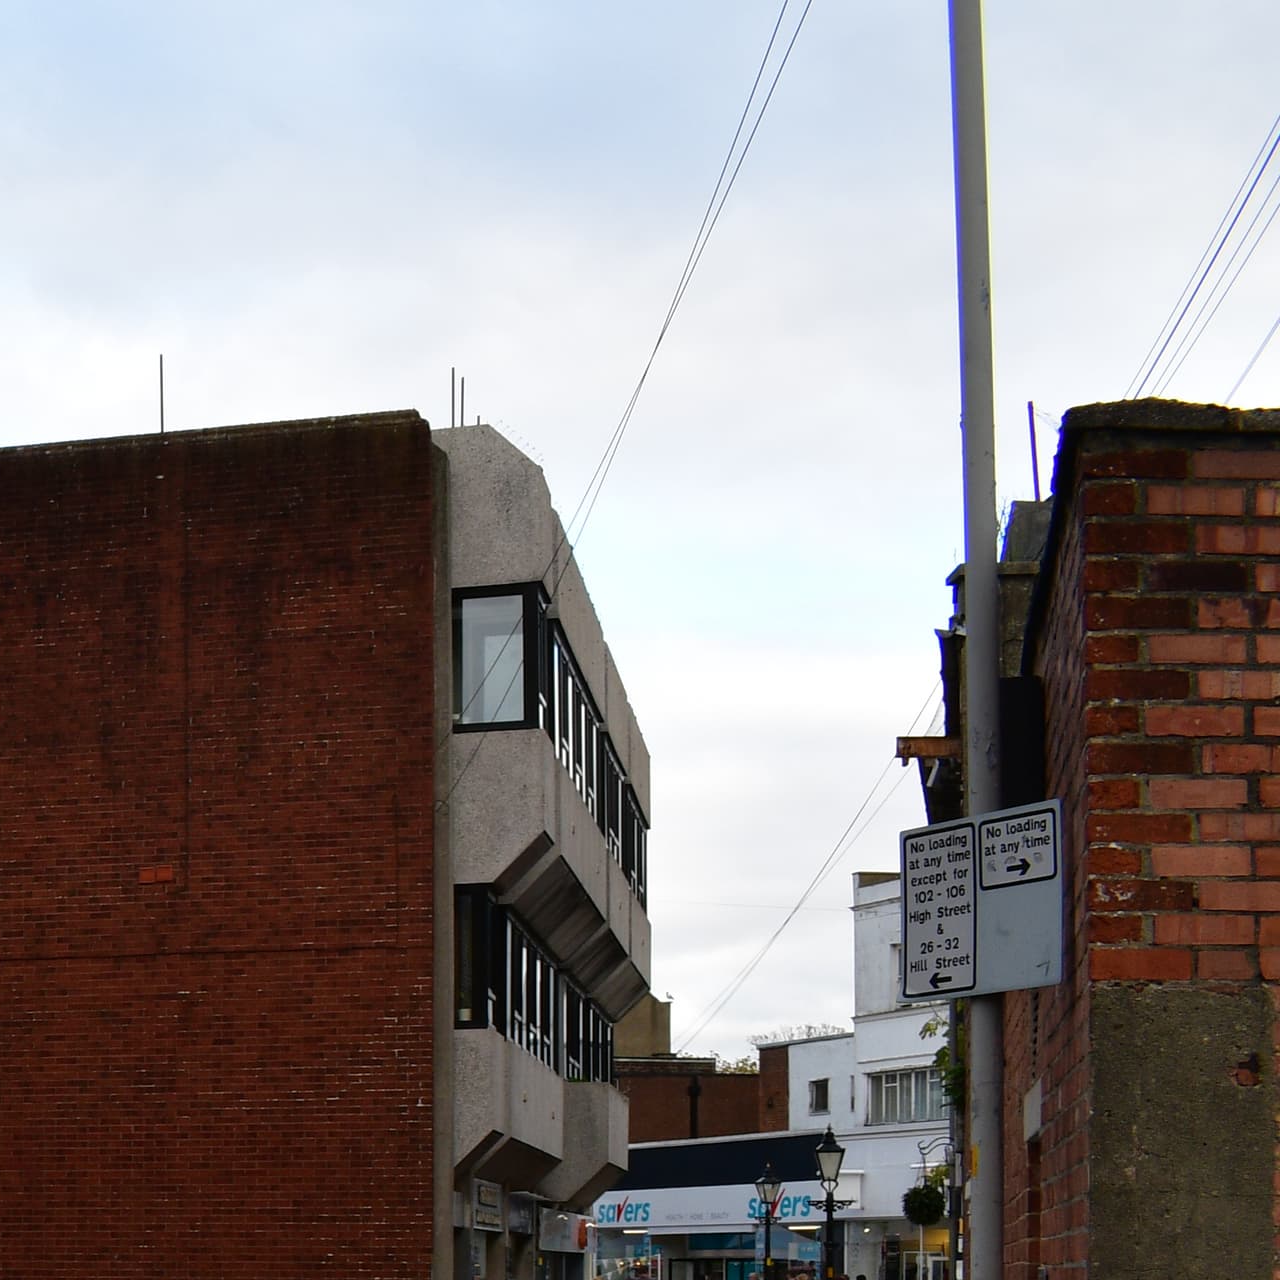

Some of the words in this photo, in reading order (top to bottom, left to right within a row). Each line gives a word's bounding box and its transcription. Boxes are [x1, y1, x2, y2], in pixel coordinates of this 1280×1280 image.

[986, 826, 1002, 839] No
[1006, 818, 1047, 835] loading
[910, 842, 925, 855] No
[928, 834, 968, 851] loading
[984, 844, 996, 857] at
[1000, 841, 1020, 854] any
[1025, 834, 1051, 848] time
[909, 859, 922, 871] at
[923, 856, 942, 869] any
[947, 849, 971, 864] time
[911, 871, 947, 887] except
[953, 867, 969, 880] for
[914, 889, 934, 904] 102
[946, 884, 966, 899] 106
[909, 909, 932, 925] High
[937, 902, 972, 919] Street
[936, 923, 944, 935] &
[920, 940, 934, 955] 26
[945, 937, 960, 951] 32
[910, 960, 928, 973] Hill
[935, 953, 970, 969] Street
[598, 1196, 651, 1223] savers
